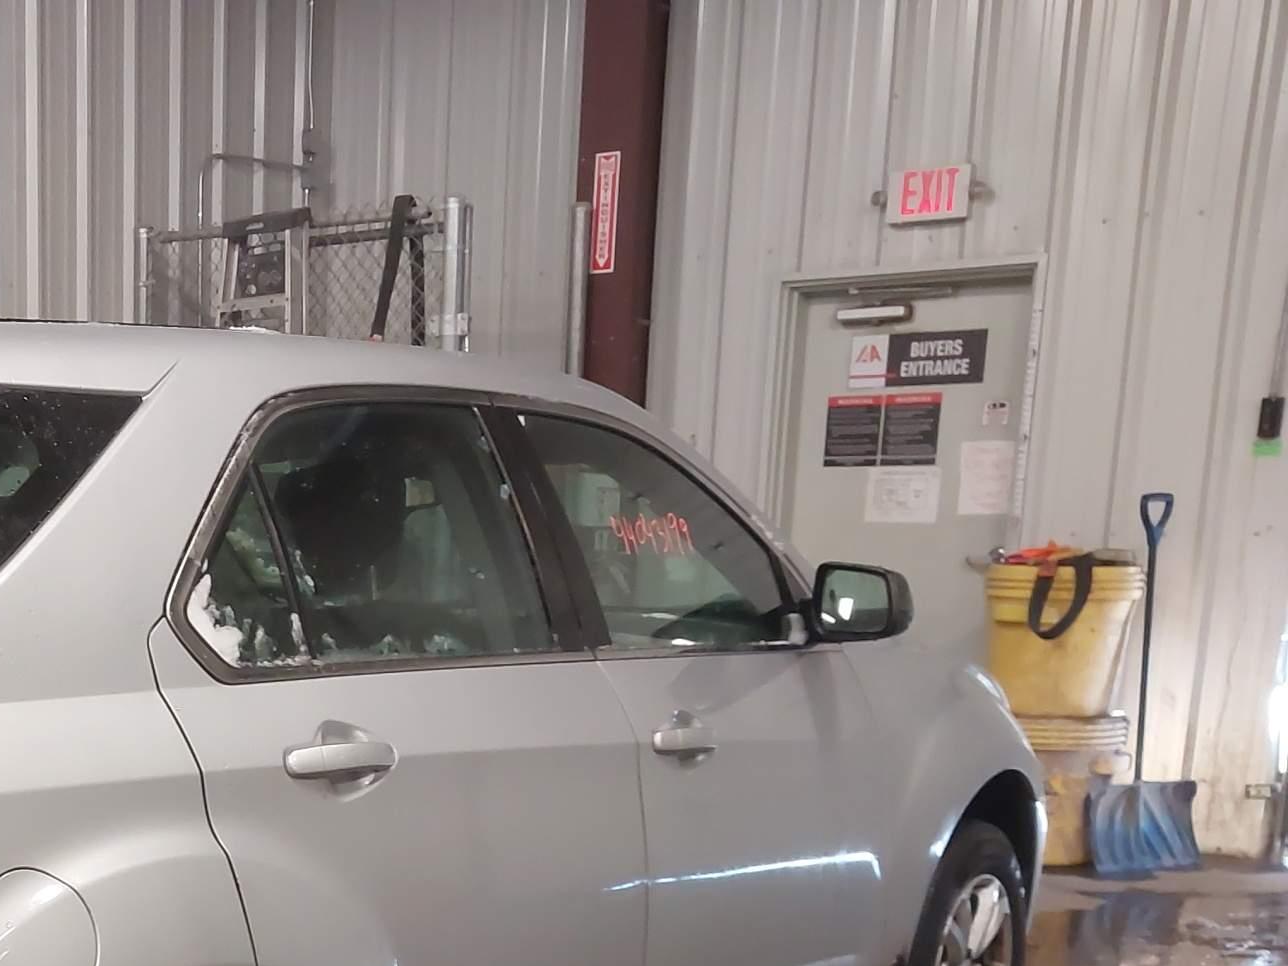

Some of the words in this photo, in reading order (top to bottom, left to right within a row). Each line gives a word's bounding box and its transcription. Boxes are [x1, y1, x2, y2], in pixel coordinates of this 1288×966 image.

[901, 167, 960, 215] EXIT
[910, 339, 964, 358] BUYERS
[900, 358, 970, 378] ENTRANCE
